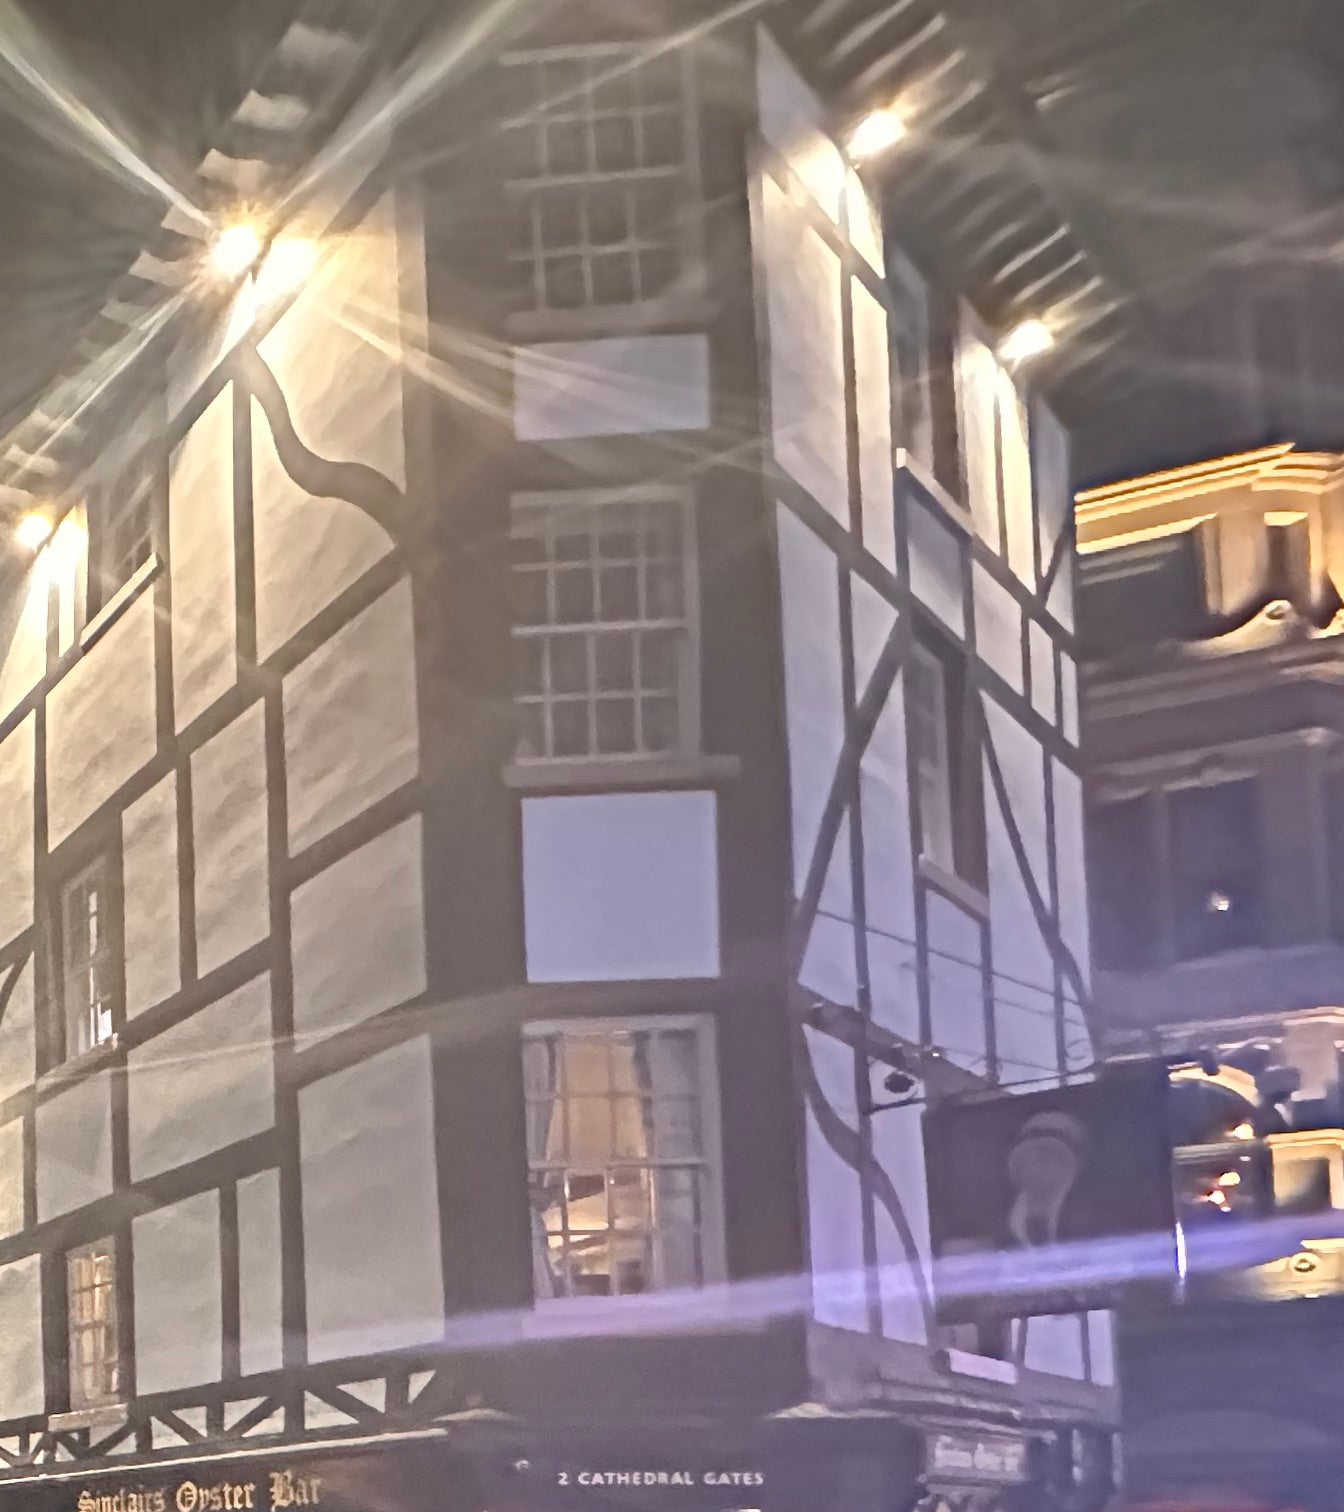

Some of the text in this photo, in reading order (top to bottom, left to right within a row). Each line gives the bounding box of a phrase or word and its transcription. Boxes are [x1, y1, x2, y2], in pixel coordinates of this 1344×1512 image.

[269, 1470, 322, 1512] Bar
[557, 1471, 765, 1486] 2 CATHEDRAL GATES
